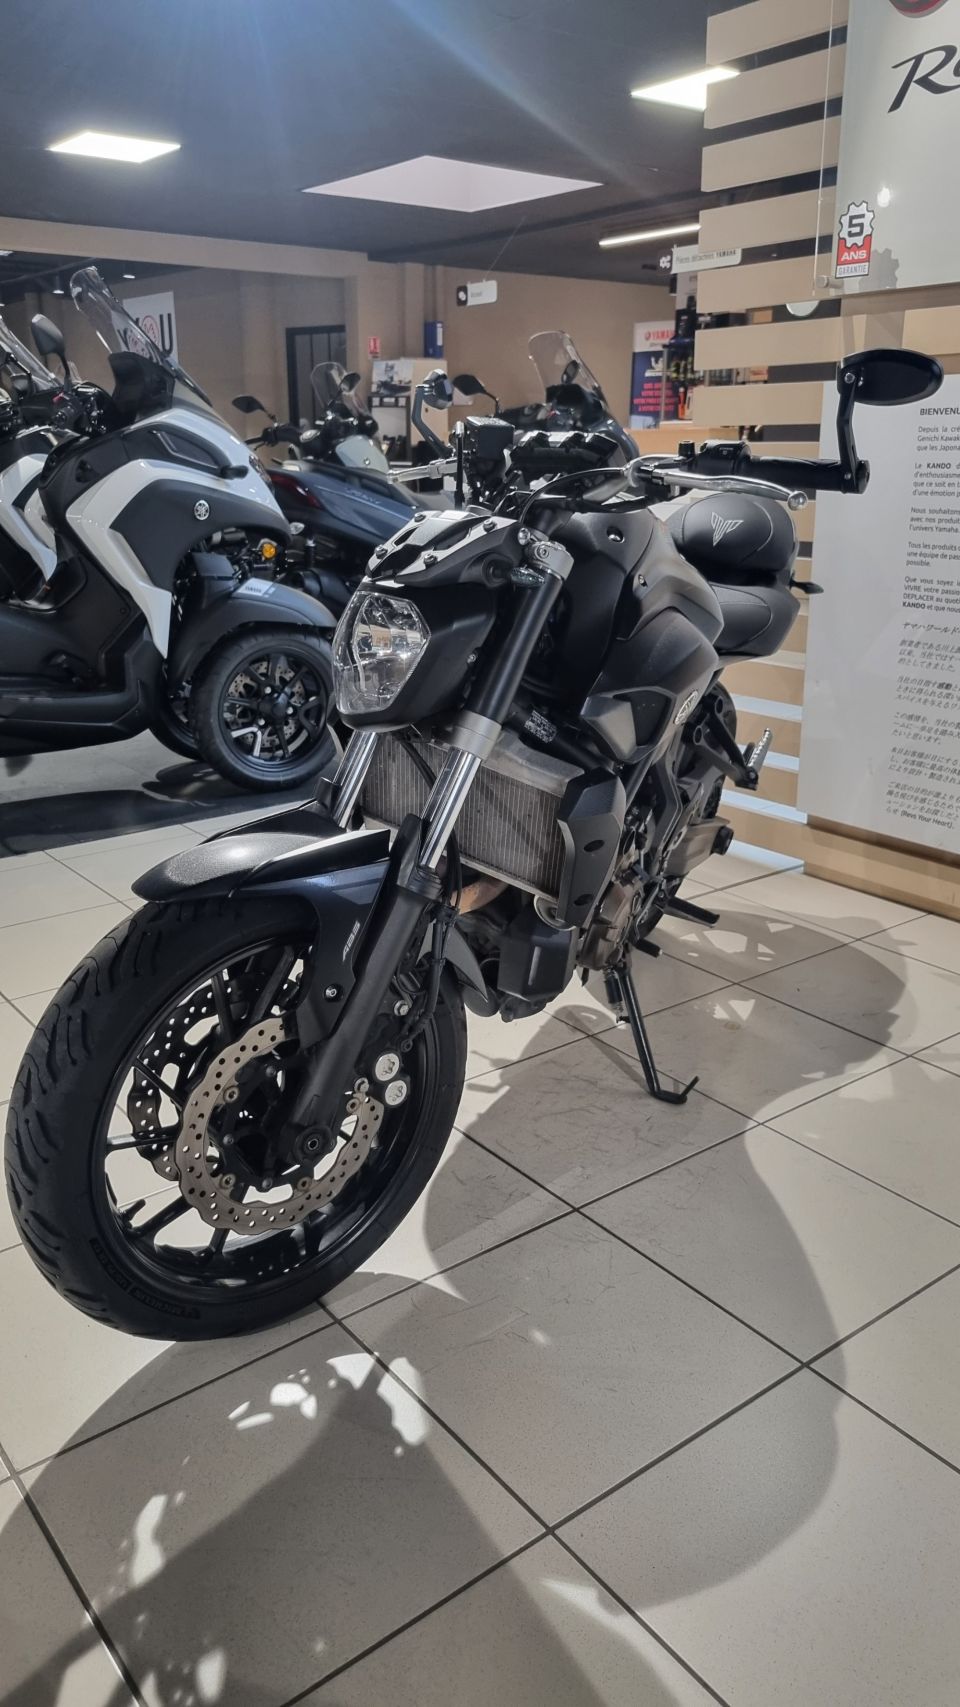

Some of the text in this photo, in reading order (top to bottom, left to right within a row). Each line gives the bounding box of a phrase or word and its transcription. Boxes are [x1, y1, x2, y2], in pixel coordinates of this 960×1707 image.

[848, 213, 865, 238] 5
[841, 249, 867, 261] ANS
[838, 265, 867, 275] GARANTIE
[918, 425, 939, 434] Depuis
[913, 481, 925, 489] que
[912, 489, 929, 497] d'une
[929, 489, 956, 497] émotion
[908, 541, 921, 549] Tous
[931, 543, 957, 552] produits
[939, 551, 948, 559] de
[904, 575, 917, 584] Que
[902, 601, 926, 610] KANDO
[926, 603, 933, 611] et
[918, 814, 932, 824] Your
